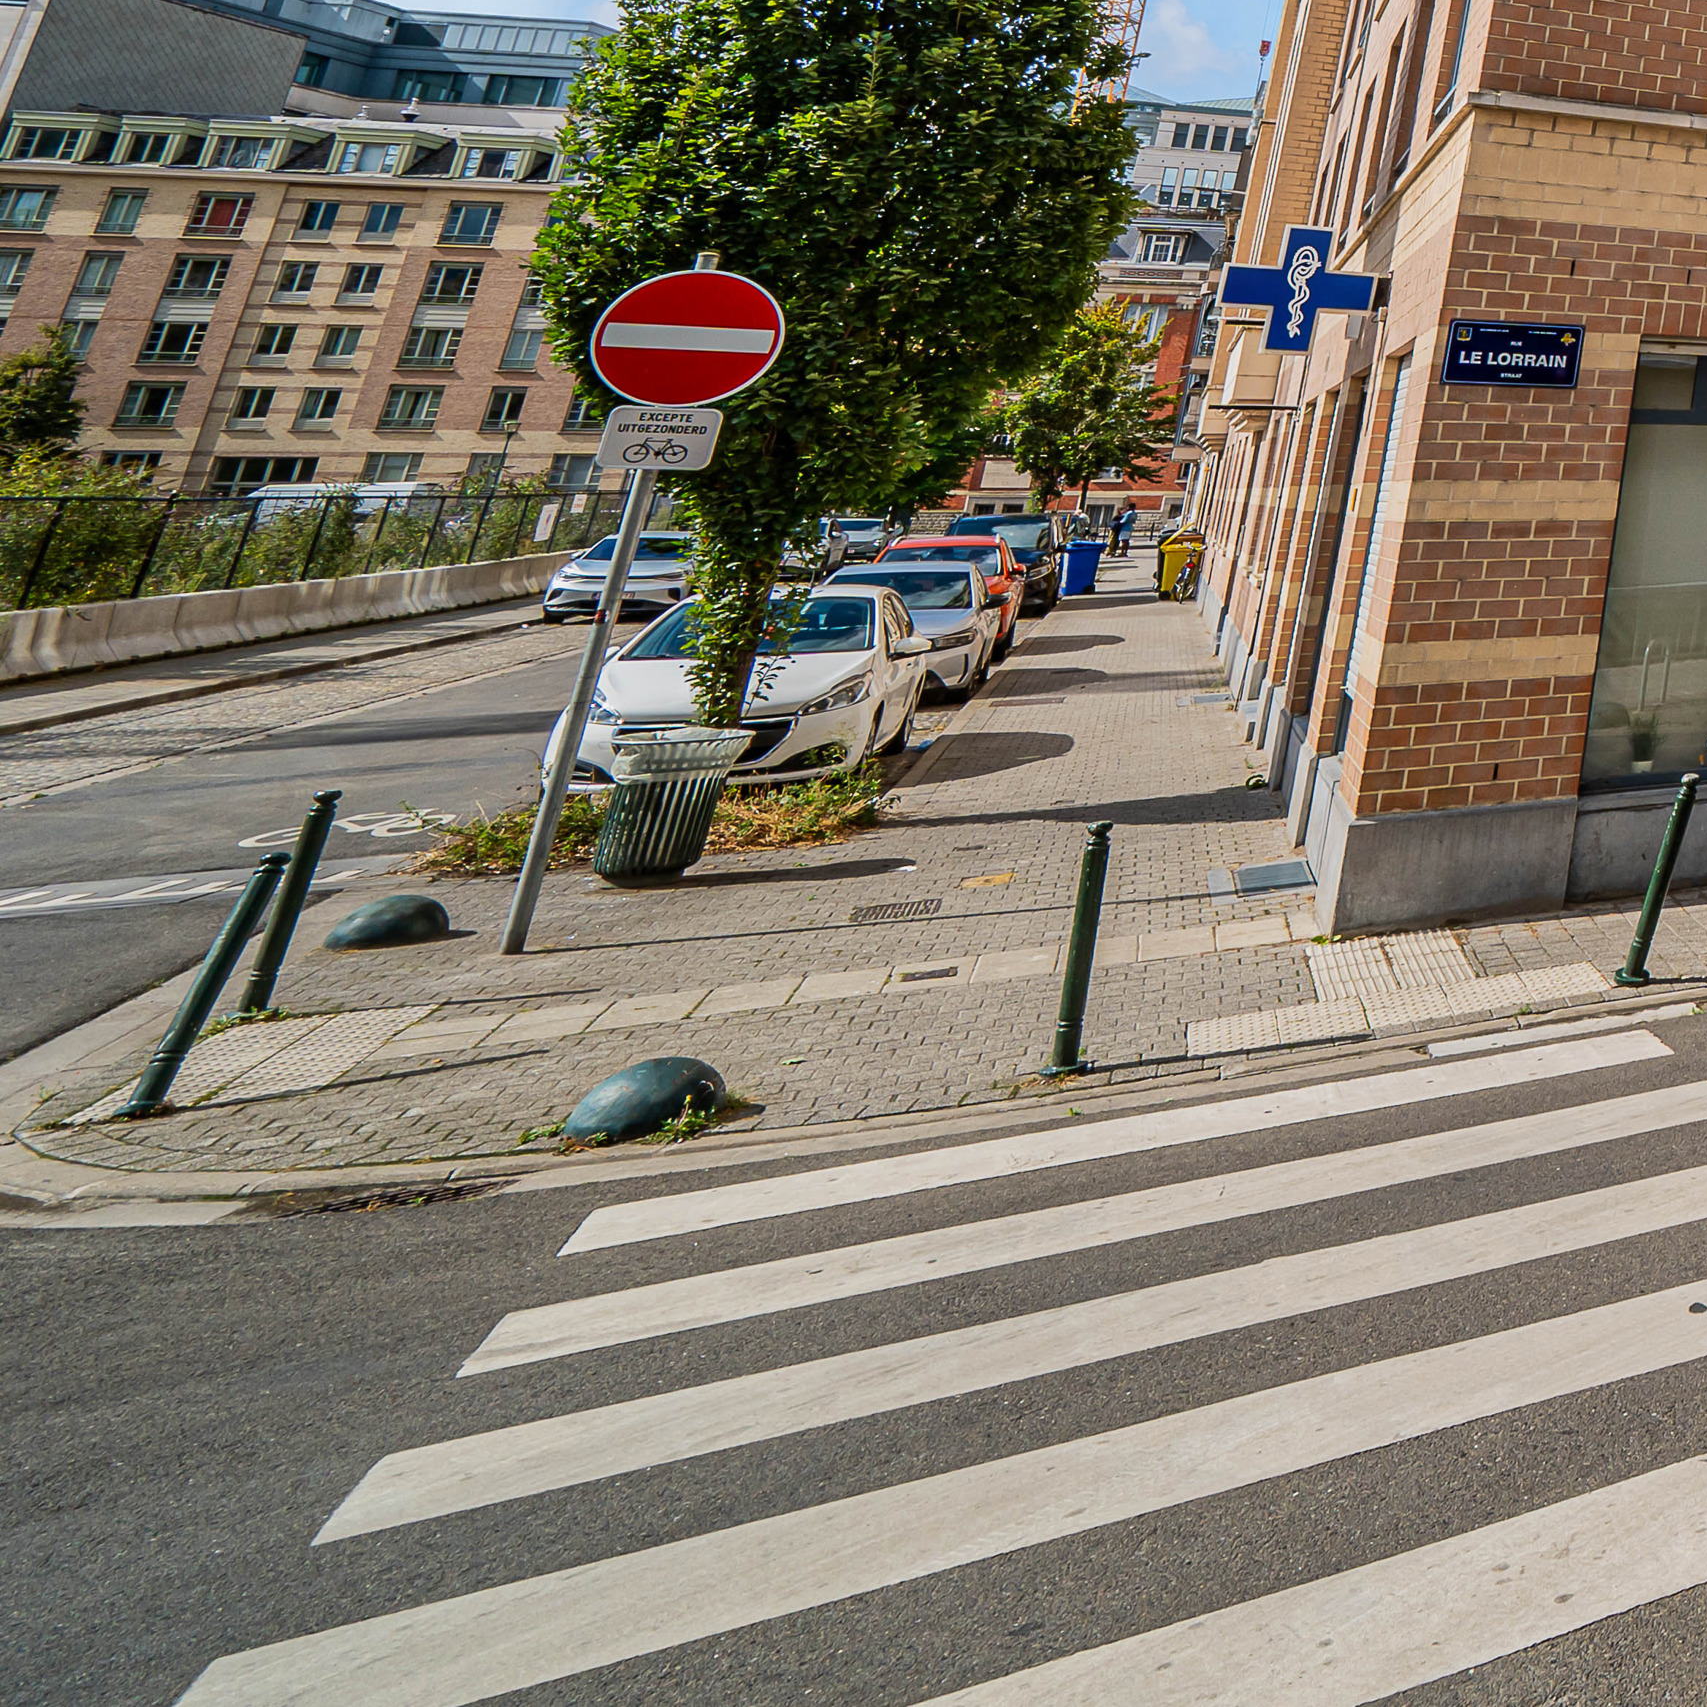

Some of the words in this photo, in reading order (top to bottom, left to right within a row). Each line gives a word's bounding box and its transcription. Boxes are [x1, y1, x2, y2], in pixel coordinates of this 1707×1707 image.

[1458, 351, 1483, 365] LE
[1486, 351, 1568, 368] LORRAIN
[638, 412, 694, 423] EXCEPTE
[617, 423, 708, 435] UITGEZONDERD
